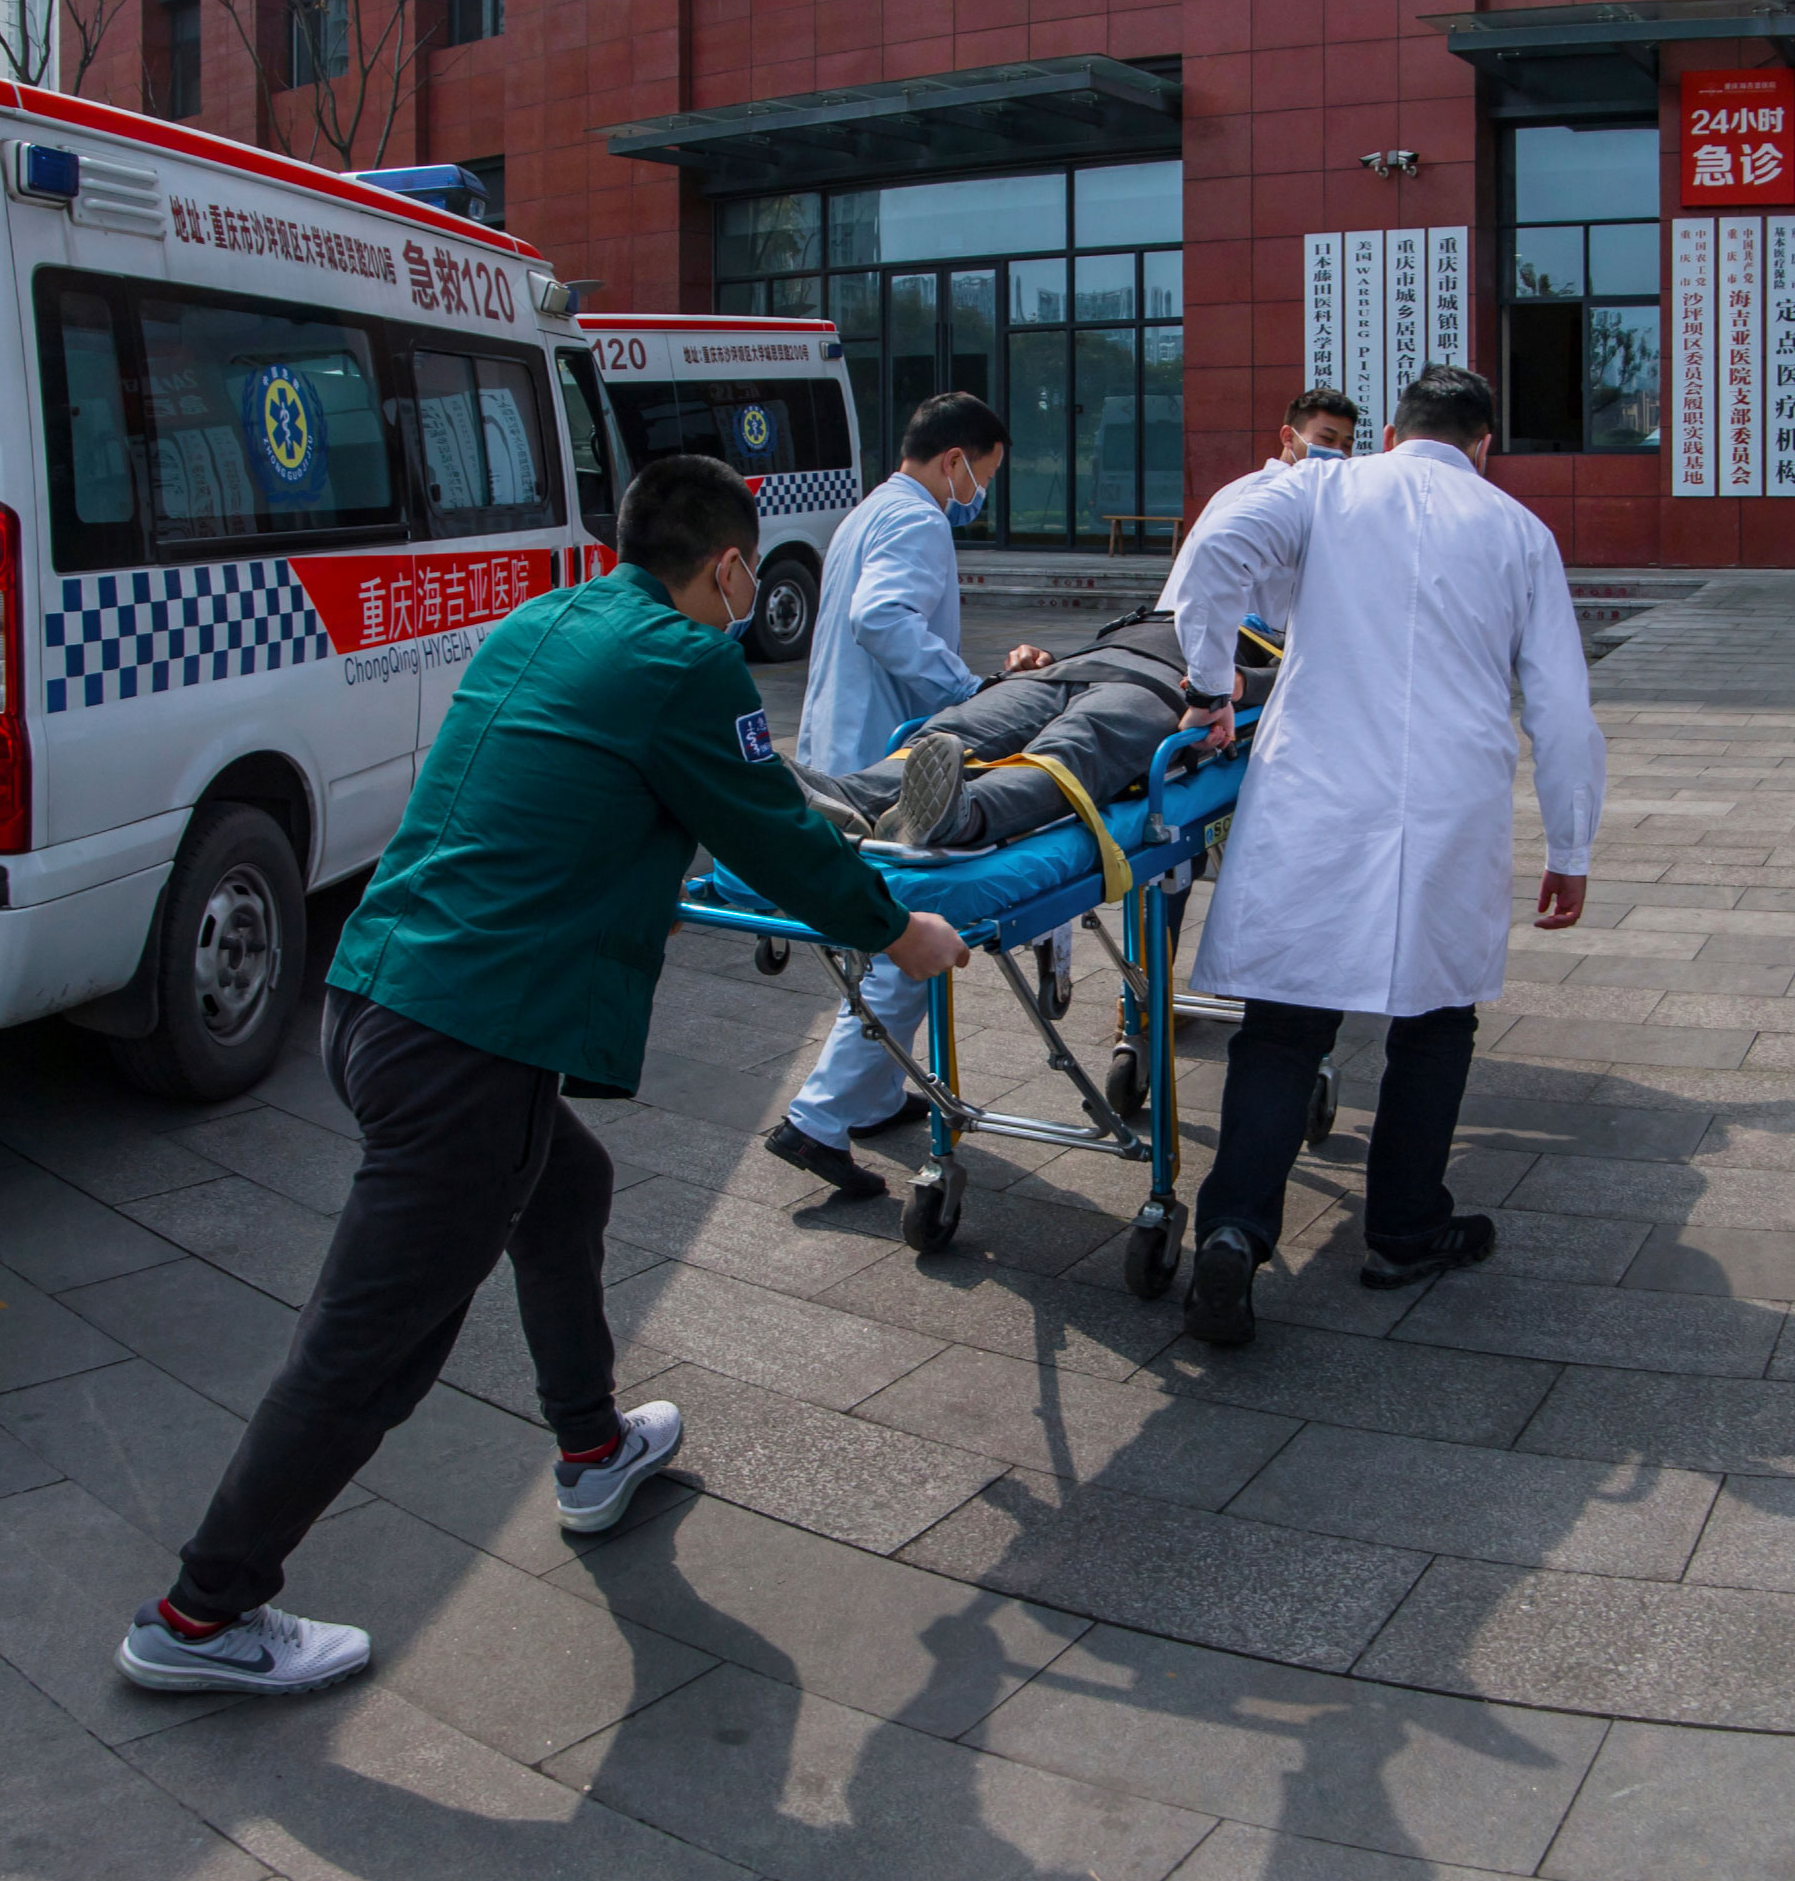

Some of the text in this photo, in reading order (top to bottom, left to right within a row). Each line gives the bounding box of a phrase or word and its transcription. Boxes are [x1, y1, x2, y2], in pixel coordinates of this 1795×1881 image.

[1690, 106, 1785, 135] 24小时
[1692, 142, 1784, 186] 急诊
[1726, 228, 1738, 284] 重庆市
[1742, 228, 1754, 284] 中国共产党
[1728, 289, 1752, 485] 海吉亚医院支部委员会
[358, 553, 529, 646] 重庆海吉亚医院
[421, 630, 474, 671] HYGEIA
